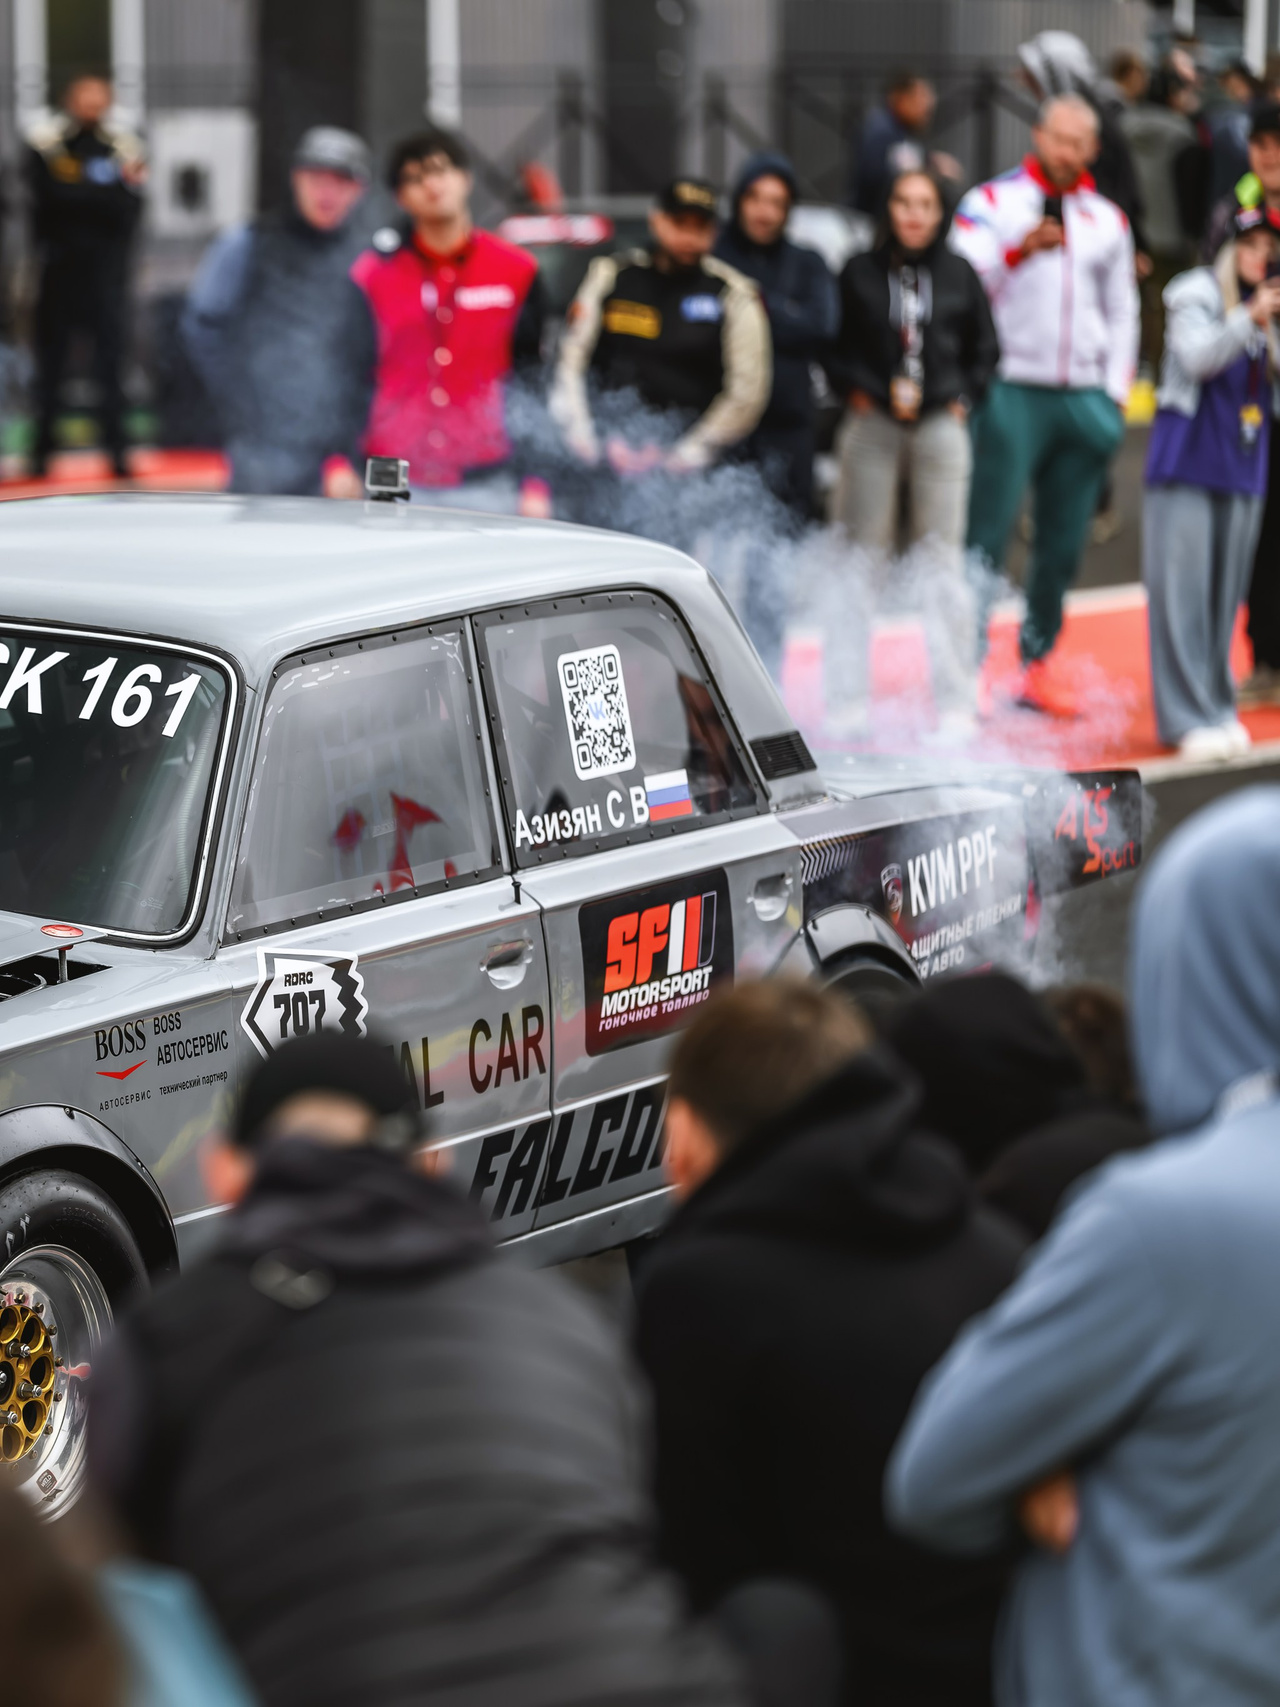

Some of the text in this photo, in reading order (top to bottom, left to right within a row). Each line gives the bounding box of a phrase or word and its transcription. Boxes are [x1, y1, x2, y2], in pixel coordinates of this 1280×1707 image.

[78, 656, 202, 738] 161
[515, 804, 602, 848] Азизян
[907, 824, 998, 917] KVM PPF
[906, 914, 974, 961] АЩИТНЫЕ
[284, 971, 313, 987] RDRC
[930, 944, 965, 976] АВТО
[600, 965, 713, 1018] MOTORSPORT
[153, 1011, 182, 1035] BOSS
[273, 989, 326, 1038] 707
[94, 1019, 147, 1061] BOSS
[157, 1030, 229, 1066] АВТОСЕРВИС
[469, 1004, 546, 1094] CAR
[100, 1090, 152, 1112] АВТОСЕРВИС
[159, 1071, 228, 1095] технический партнер
